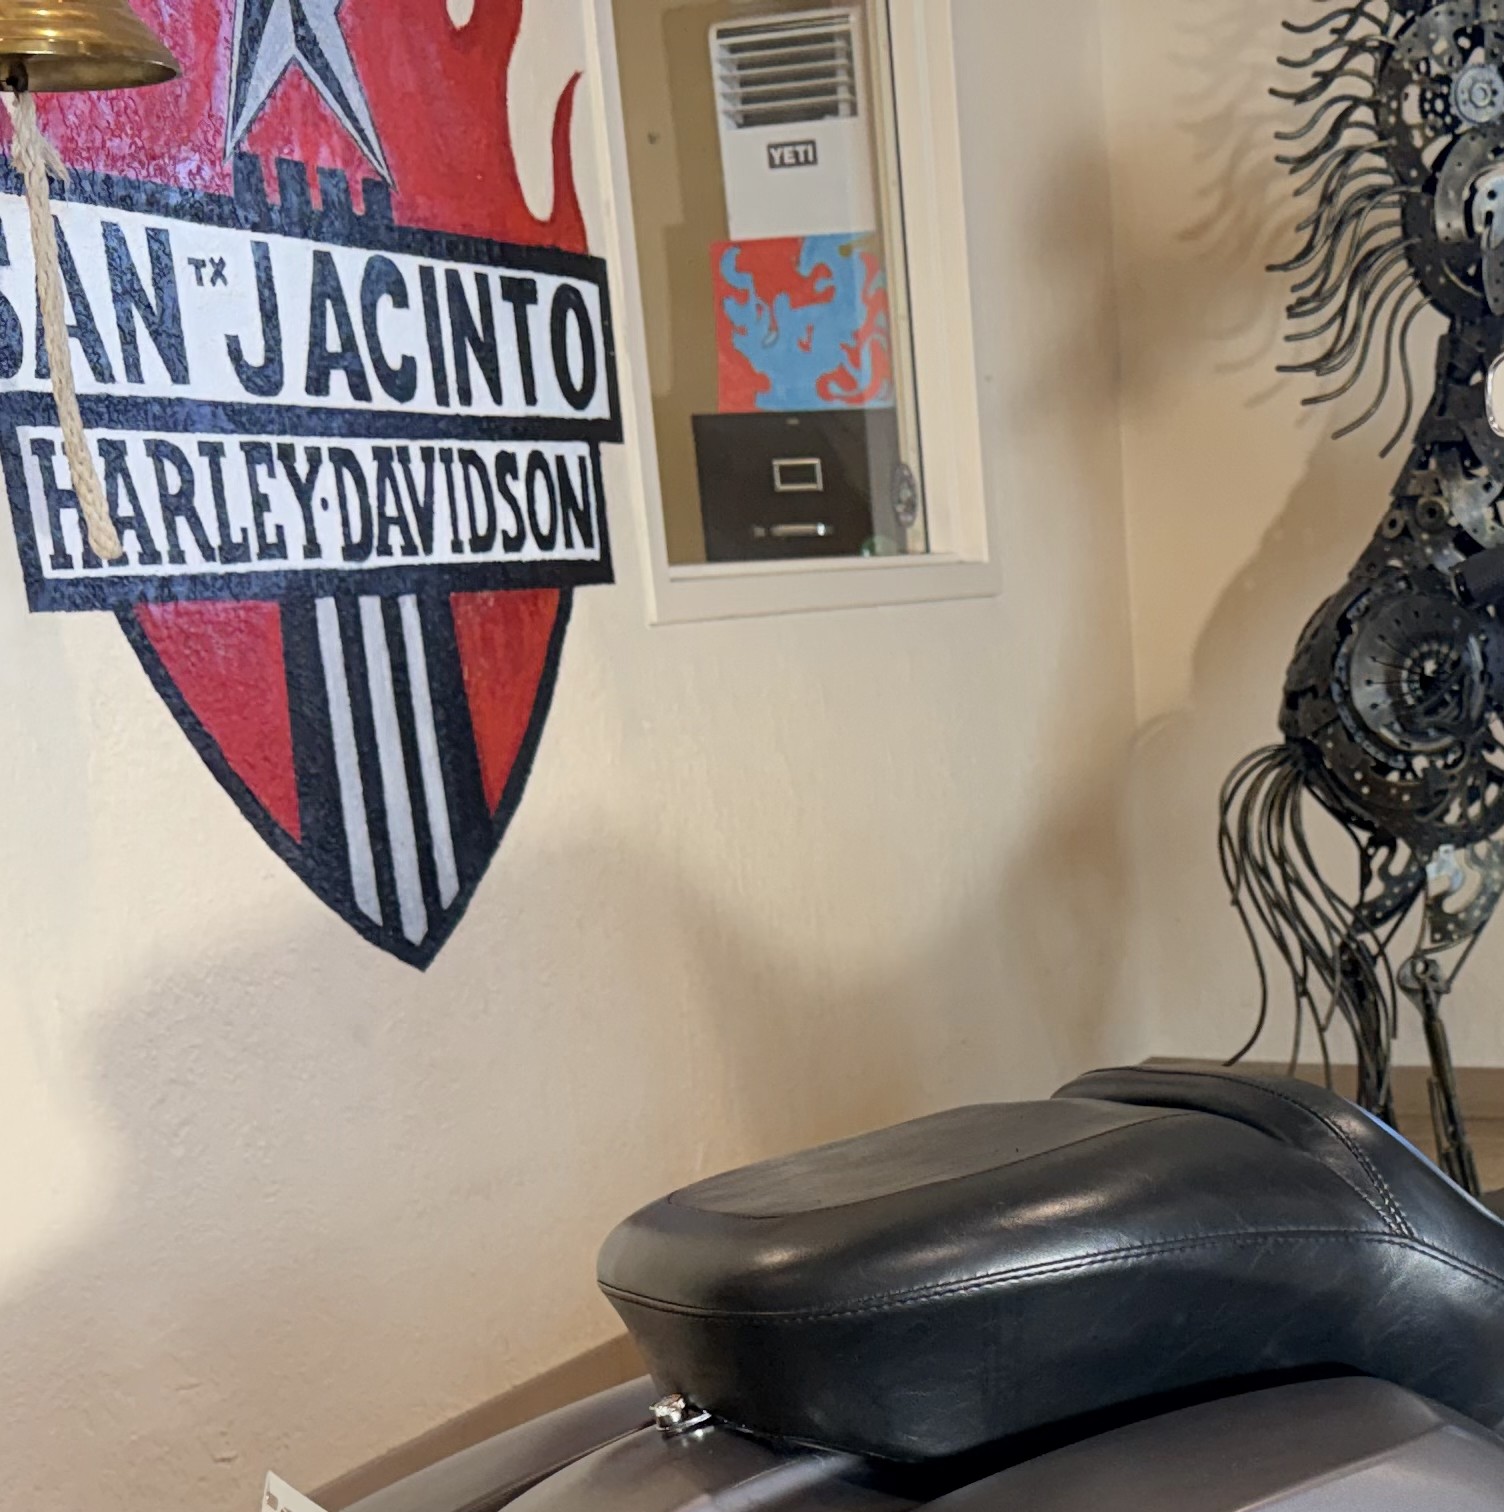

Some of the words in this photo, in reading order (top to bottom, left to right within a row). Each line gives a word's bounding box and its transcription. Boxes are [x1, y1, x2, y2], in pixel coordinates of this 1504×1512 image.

[769, 143, 813, 165] YETI
[187, 256, 228, 287] TX
[226, 241, 597, 410] JACINTO
